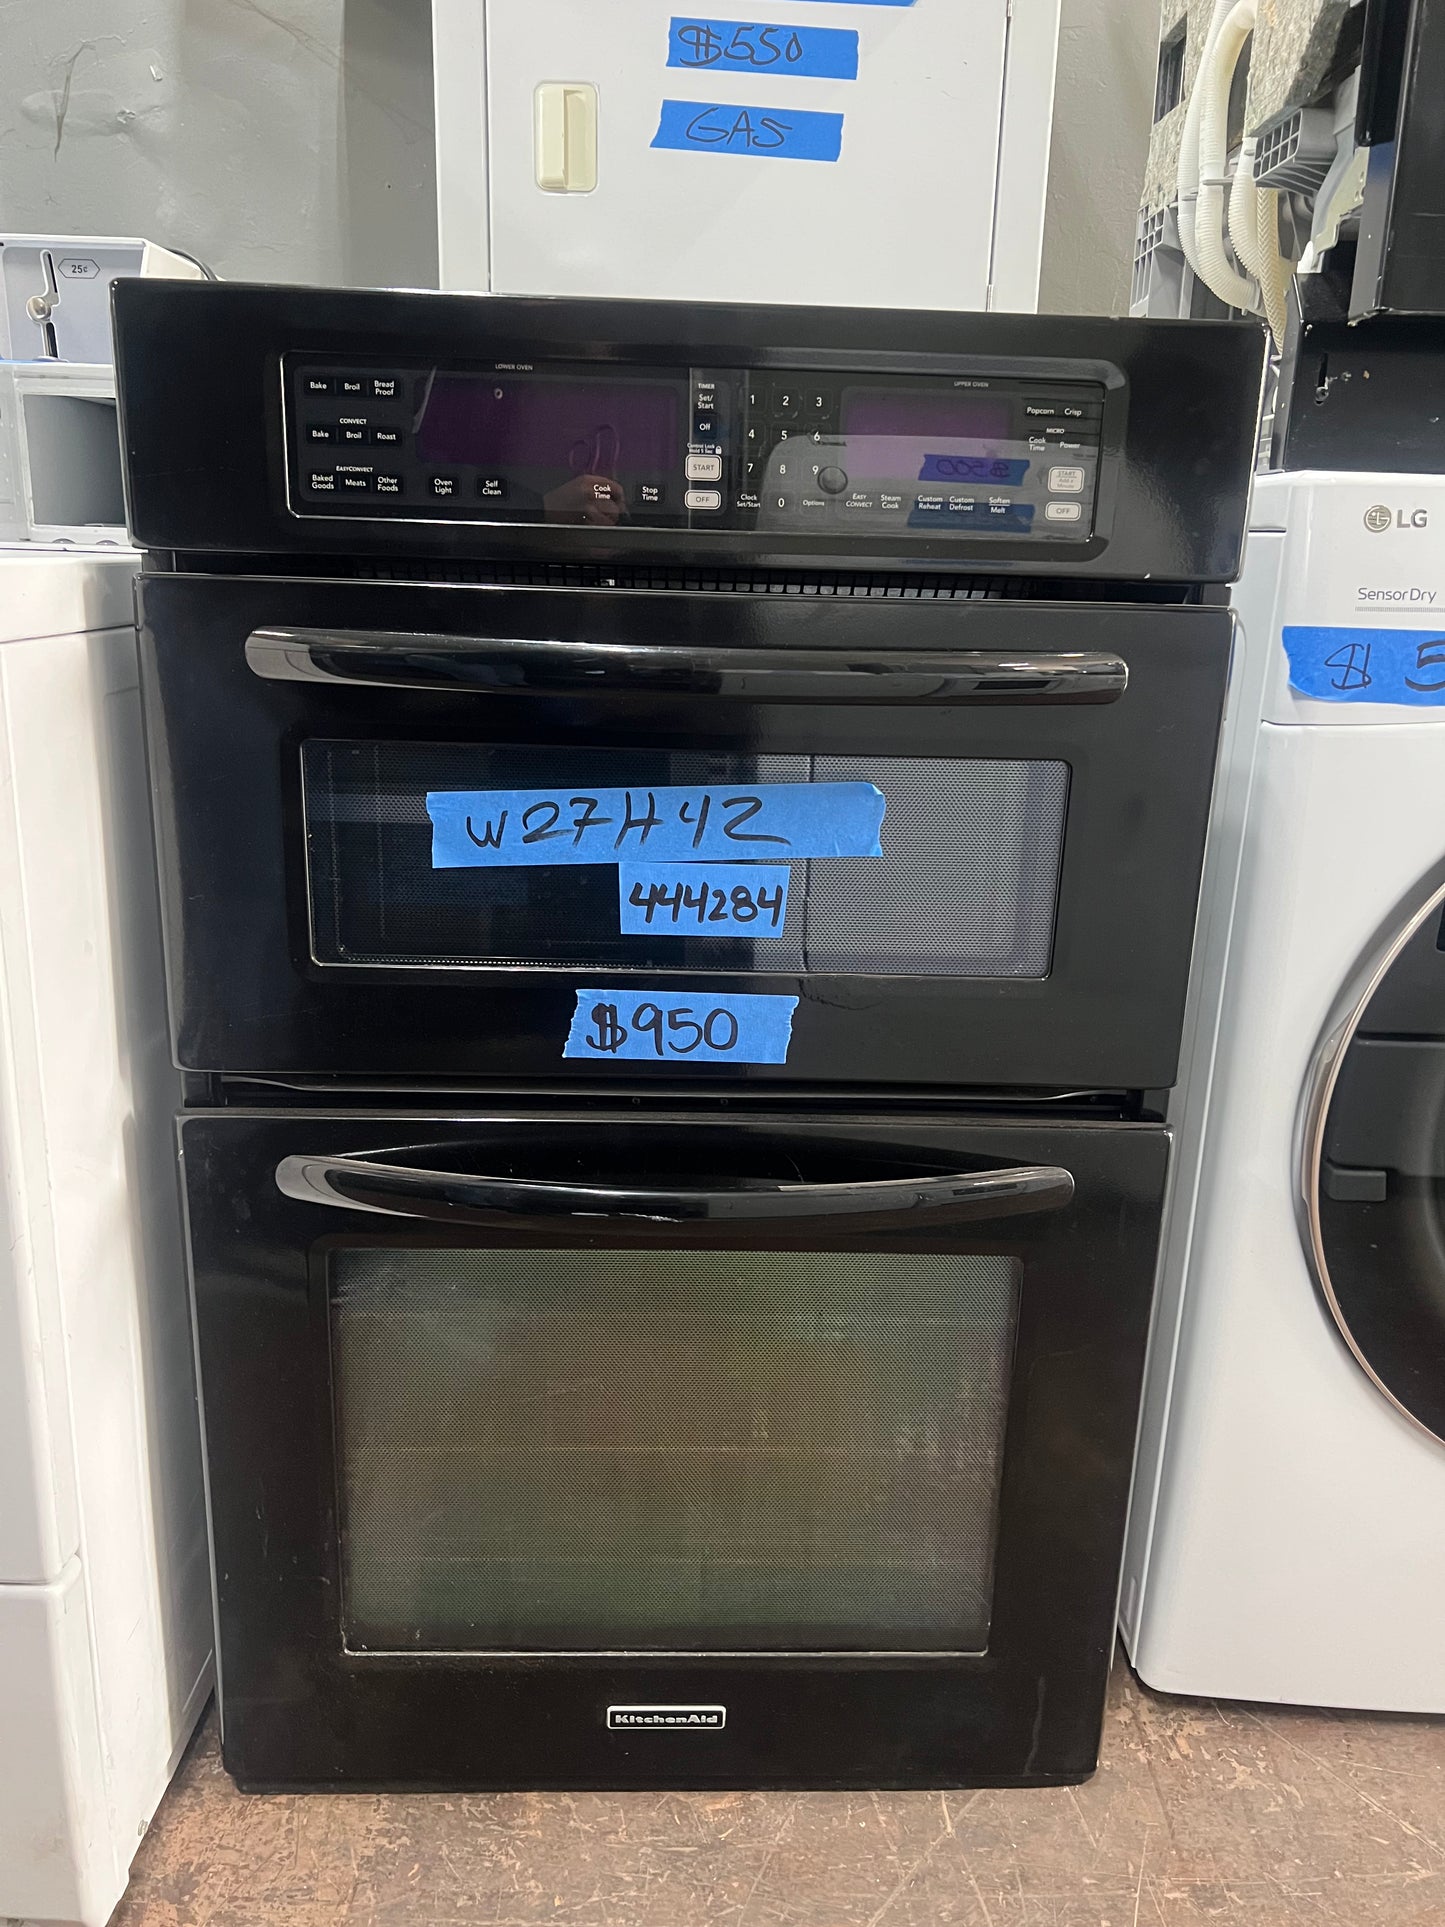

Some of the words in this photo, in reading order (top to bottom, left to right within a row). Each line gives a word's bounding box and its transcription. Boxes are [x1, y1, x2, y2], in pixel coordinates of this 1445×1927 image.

[678, 24, 803, 67] $550
[685, 108, 793, 148] GAS
[71, 264, 88, 274] 25¢
[310, 381, 328, 390] Bake
[344, 382, 361, 391] Broil
[374, 379, 395, 388] Bread
[375, 388, 395, 396] Proof
[698, 393, 714, 402] Set/
[750, 394, 756, 405] 1
[782, 395, 790, 406] 2
[815, 396, 823, 407] 3
[697, 402, 714, 410] Start
[1026, 406, 1055, 416] Popcorn
[1064, 408, 1082, 417] Crisp
[699, 423, 711, 431] Off
[312, 430, 330, 438] Bake
[346, 431, 362, 440] Broil
[377, 432, 397, 440] Roast
[748, 428, 756, 439] 4
[781, 430, 789, 441] 5
[813, 431, 821, 442] 6
[1028, 436, 1047, 444] Cook
[1029, 444, 1046, 452] Time
[1059, 441, 1080, 449] Power
[692, 463, 715, 472] START
[747, 462, 754, 473] 7
[779, 464, 787, 475] 8
[812, 465, 819, 475] 9
[312, 474, 334, 482] Baked
[377, 476, 398, 484] Other
[434, 478, 453, 486] Oven
[311, 482, 335, 490] Goods
[345, 479, 367, 487] Meats
[485, 480, 499, 488] Self
[377, 484, 399, 492] Foods
[435, 486, 453, 495] Light
[482, 487, 502, 496] Clean
[593, 484, 612, 492] Cook
[642, 486, 659, 495] Stop
[594, 492, 611, 500] Time
[642, 493, 659, 502] Time
[740, 493, 758, 501] Clock
[852, 492, 867, 500] EASY
[880, 494, 902, 502] Steam
[918, 494, 944, 503] Custom
[949, 496, 975, 504] Custom
[989, 496, 1011, 504] Soften
[778, 497, 785, 508] 0
[802, 499, 825, 507] Options
[846, 500, 872, 508] CONVECT
[881, 501, 899, 509] Cook
[918, 502, 942, 510] Reheat
[949, 503, 974, 512] Defrost
[990, 506, 1006, 514] Melt
[1055, 507, 1071, 515] OFF
[1396, 508, 1428, 529] LG
[629, 882, 783, 928] 444284
[585, 1002, 739, 1057] $950
[615, 1714, 718, 1724] KitchenAid
